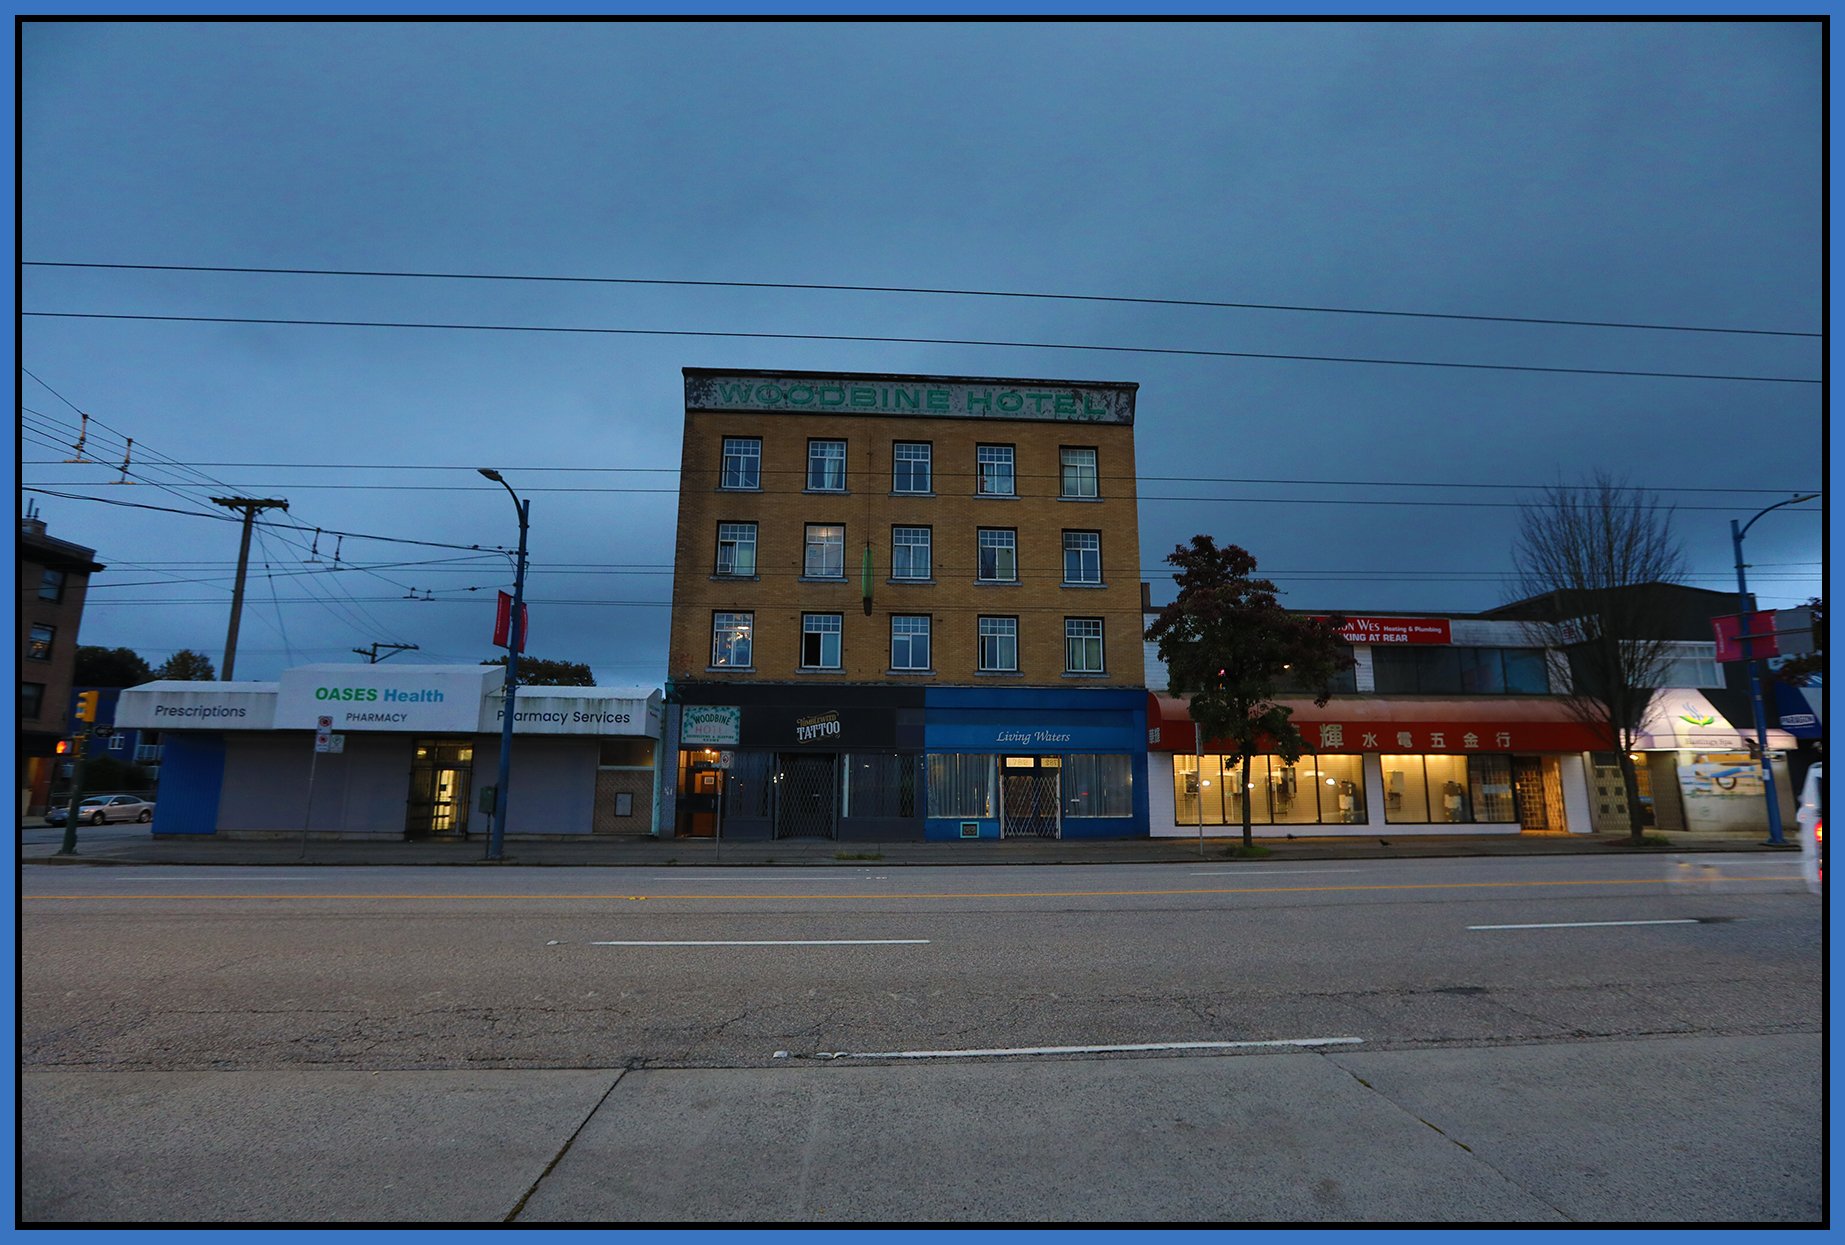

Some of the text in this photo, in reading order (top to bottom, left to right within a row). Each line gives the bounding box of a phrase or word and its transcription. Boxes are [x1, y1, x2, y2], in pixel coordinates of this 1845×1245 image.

[719, 383, 1107, 416] WOODBINE HOTEL
[1383, 625, 1407, 633] Heating
[1414, 626, 1442, 634] Plumbing
[1369, 633, 1380, 641] AT
[1383, 633, 1408, 642] REAR
[315, 687, 444, 702] OASES Health
[154, 704, 247, 720] Prescriptions
[346, 712, 408, 723] PHARMACY
[496, 710, 630, 725] Parmacy Services
[693, 713, 731, 726] WOODBINE
[796, 720, 841, 741] TATTOO
[996, 730, 1071, 745] Living Waters
[1291, 722, 1512, 748] 輝水電五金行
